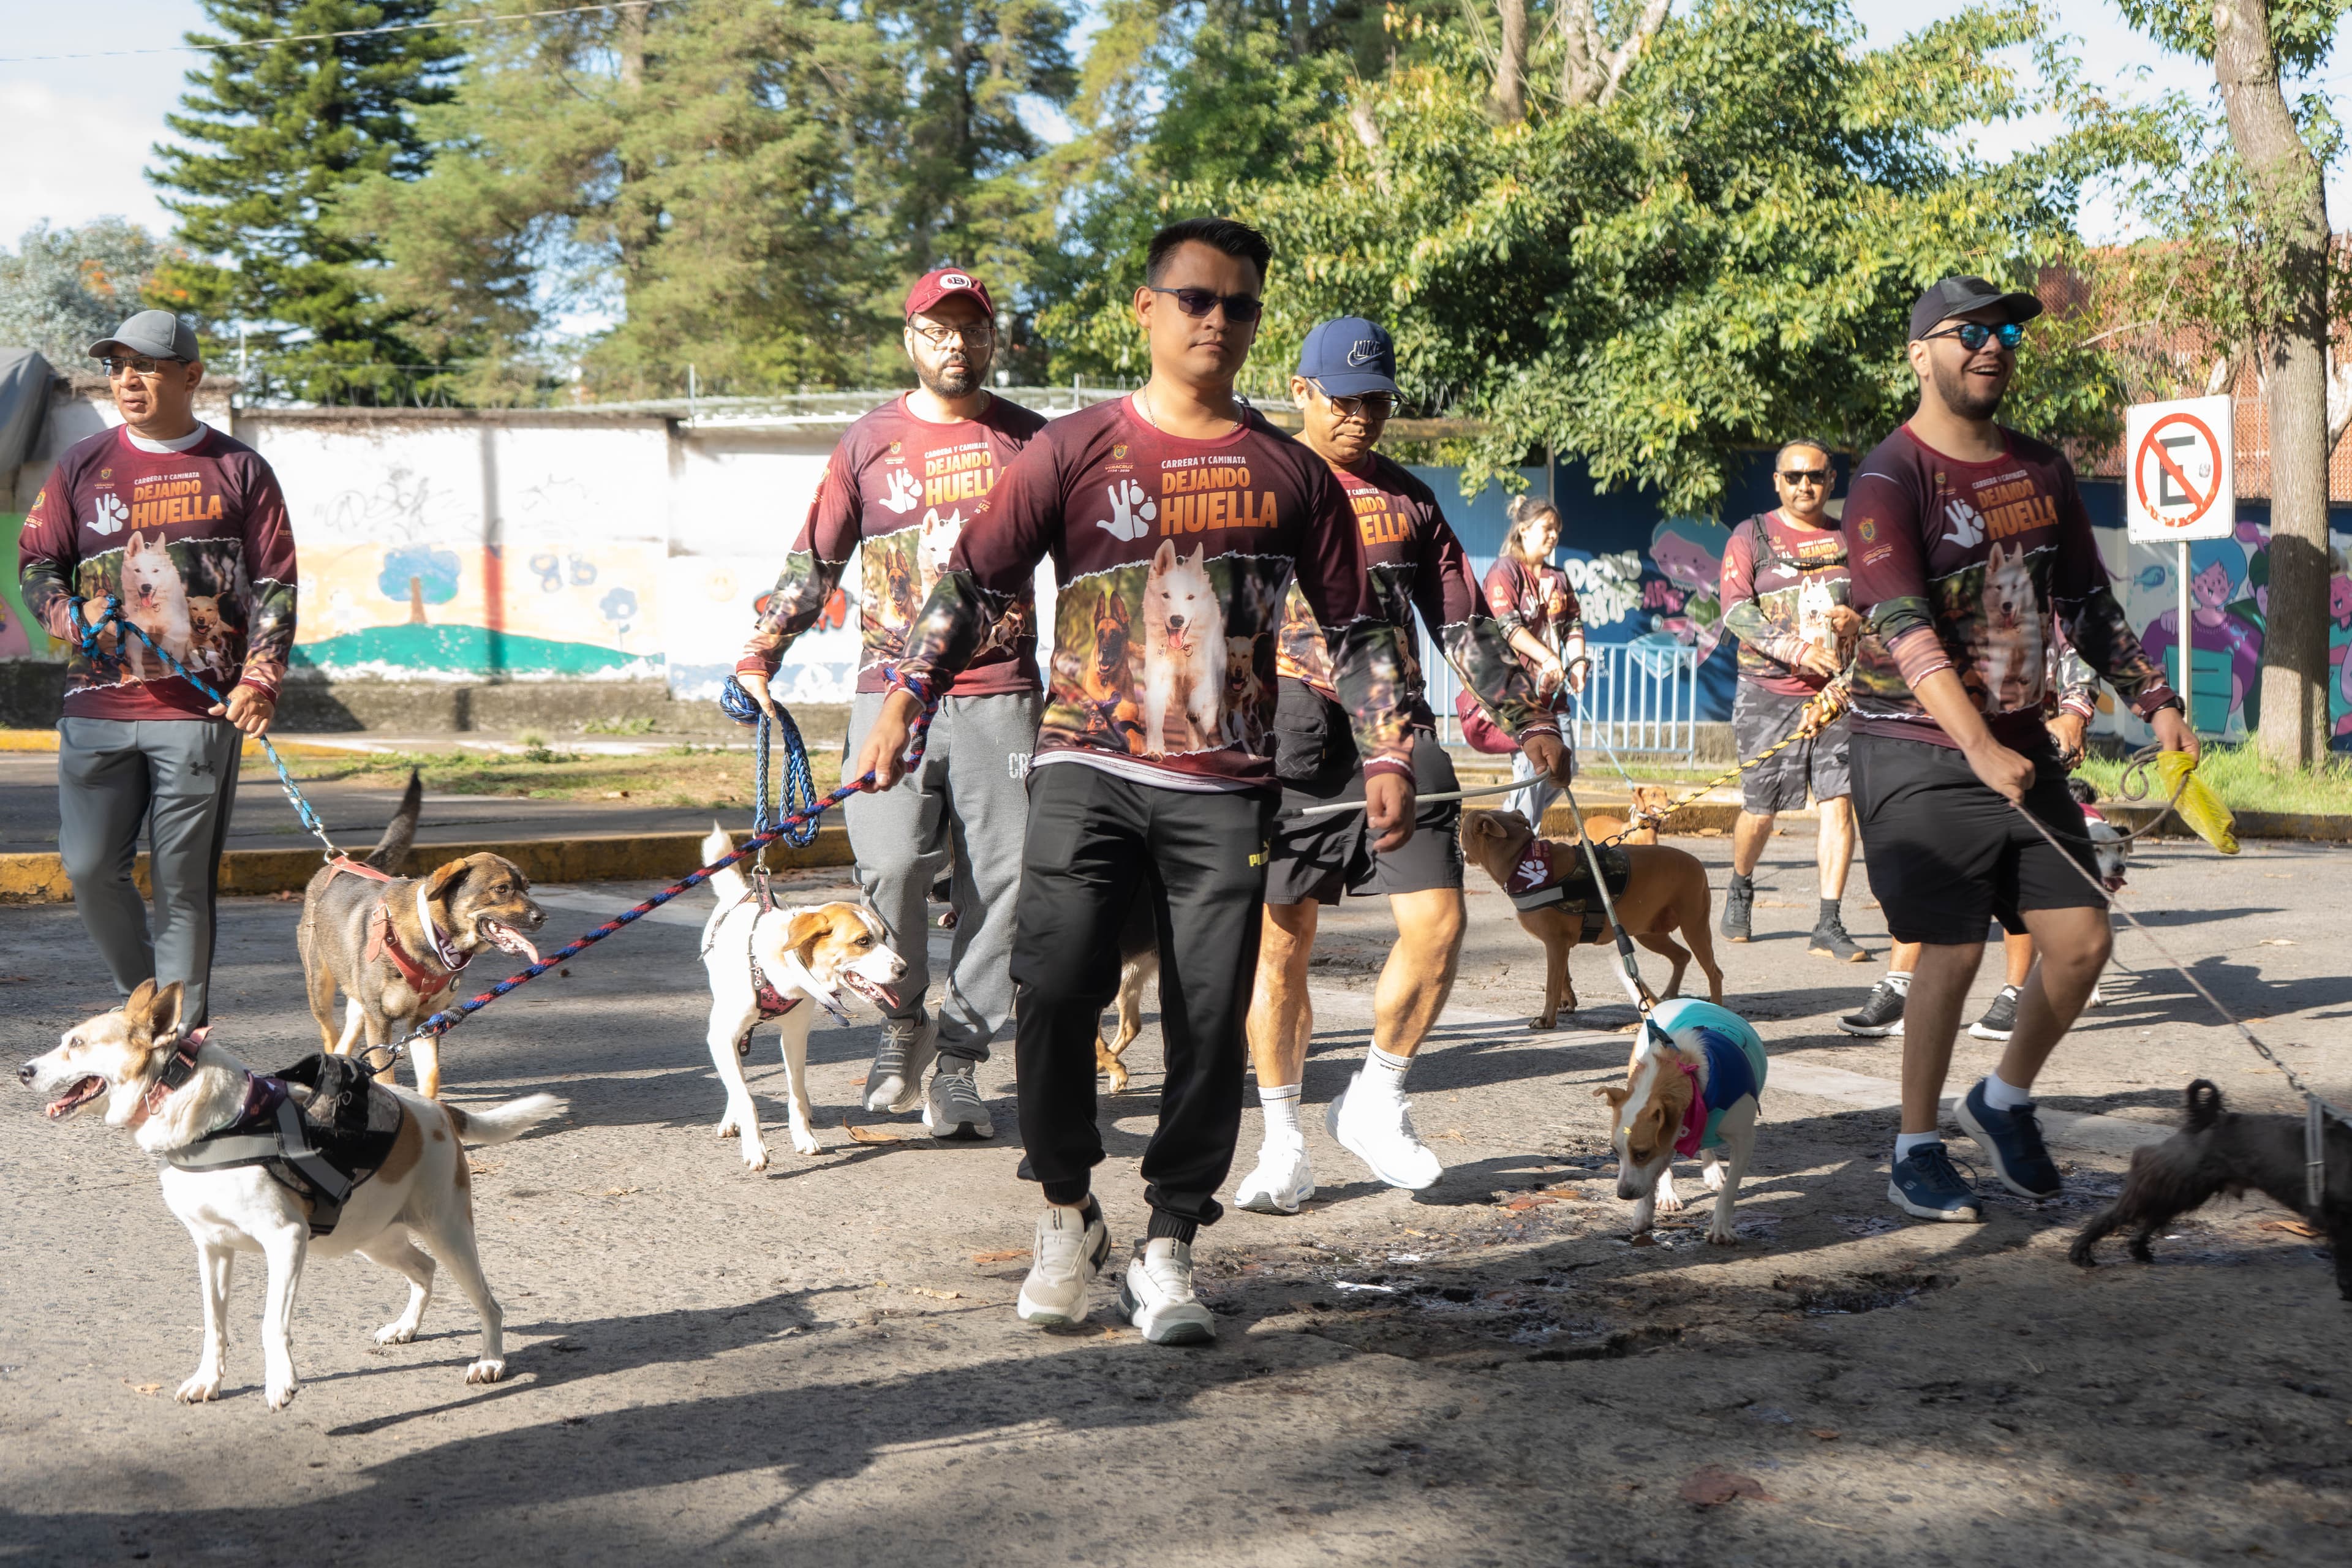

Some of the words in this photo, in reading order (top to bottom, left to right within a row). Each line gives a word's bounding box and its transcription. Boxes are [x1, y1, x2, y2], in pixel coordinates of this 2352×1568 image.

[925, 451, 992, 477] DEJANDO
[1161, 457, 1199, 469] CARRERA
[1200, 456, 1206, 465] Y
[1208, 456, 1246, 465] CAMINATA
[2159, 435, 2196, 507] E
[133, 480, 202, 502] DEJANDO
[134, 476, 162, 485] CARRERA
[169, 472, 200, 480] CAMINATA
[925, 466, 1006, 507] HUELL
[1162, 467, 1251, 495] DEJANDO
[1976, 478, 2035, 509] DEJANDO
[131, 495, 223, 530] HUELLA
[1161, 491, 1278, 537] HUELLA
[1983, 495, 2059, 541] HUELLA
[1359, 513, 1411, 546] ELLA
[1799, 542, 1839, 559] DEJANDO
[1008, 752, 1033, 779] CR
